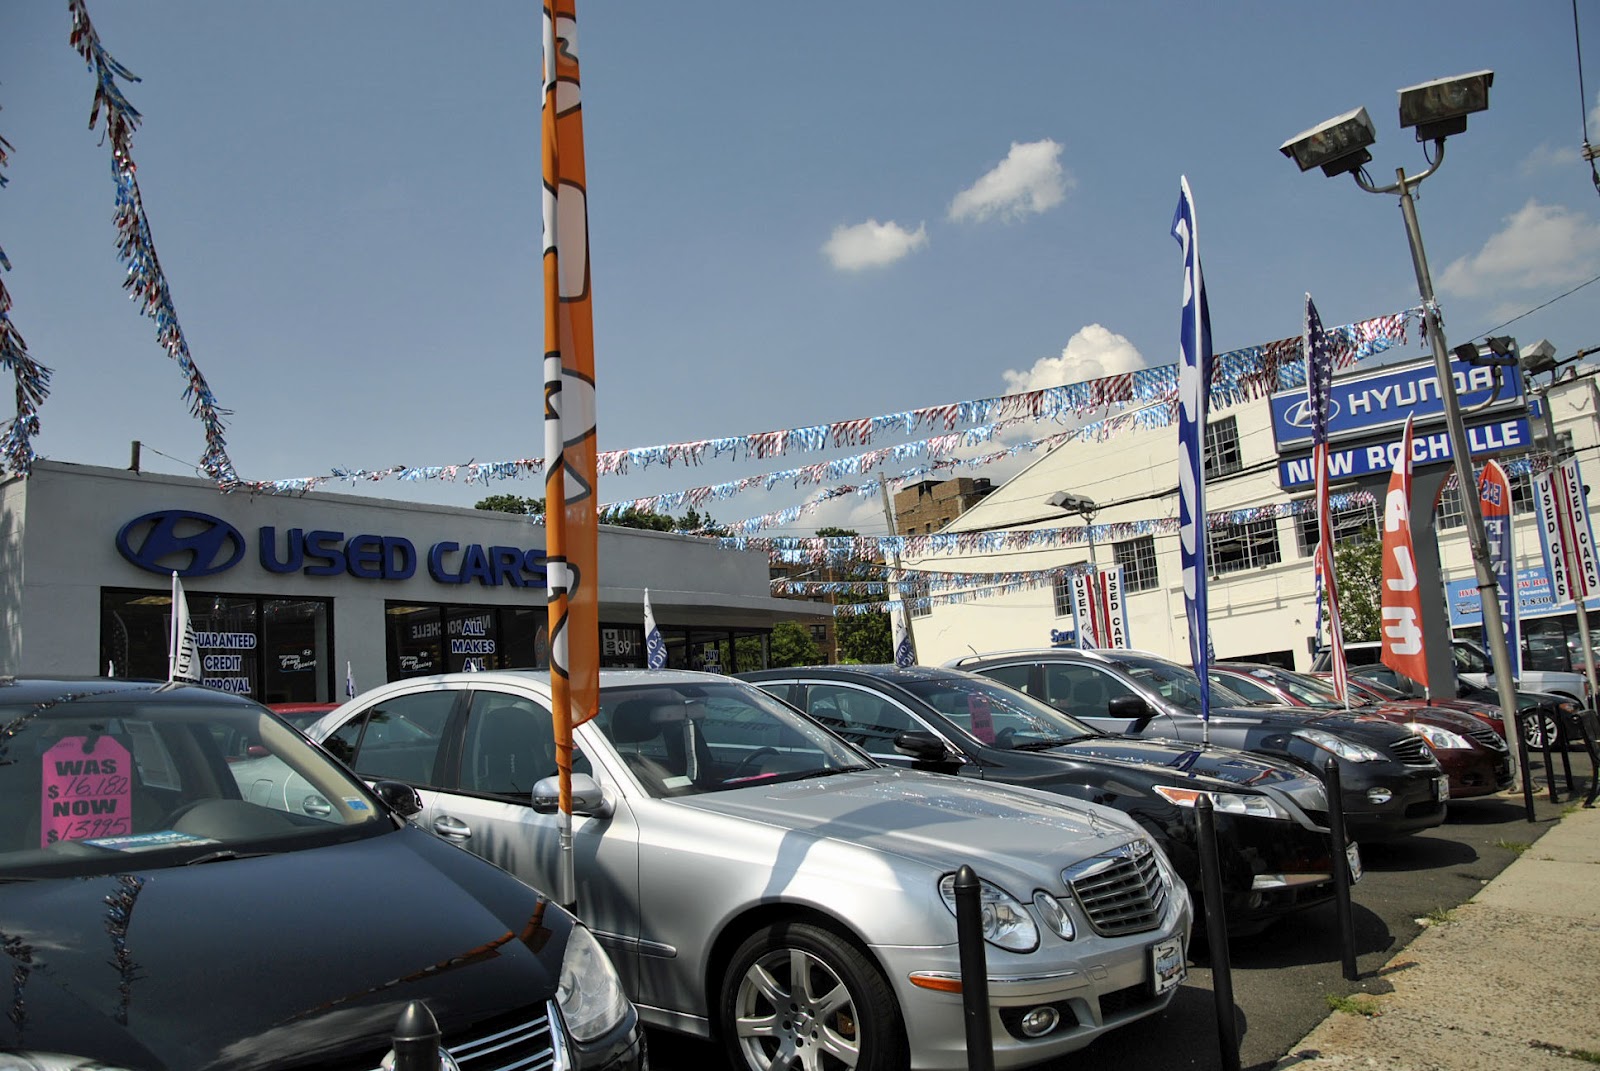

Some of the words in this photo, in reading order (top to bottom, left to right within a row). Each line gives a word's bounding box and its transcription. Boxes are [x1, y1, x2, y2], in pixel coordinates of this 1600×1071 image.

[1287, 451, 1354, 483] NW
[1367, 421, 1521, 470] ROCHLLE
[1540, 480, 1556, 534] USED
[1551, 542, 1566, 596] CARS
[1567, 467, 1582, 522] USED
[1579, 532, 1597, 588] CARS
[259, 526, 417, 580] USED
[427, 541, 547, 588] CARS
[1075, 579, 1087, 617] USED
[1107, 572, 1119, 611] USED
[462, 620, 486, 636] ALL
[1112, 617, 1124, 649] CAR
[451, 639, 496, 654] MAKES
[704, 650, 718, 661] BUY
[204, 654, 241, 671] CREDIT
[203, 677, 251, 694] PPROVAL
[55, 759, 117, 776] WAS
[52, 799, 117, 817] NOW
